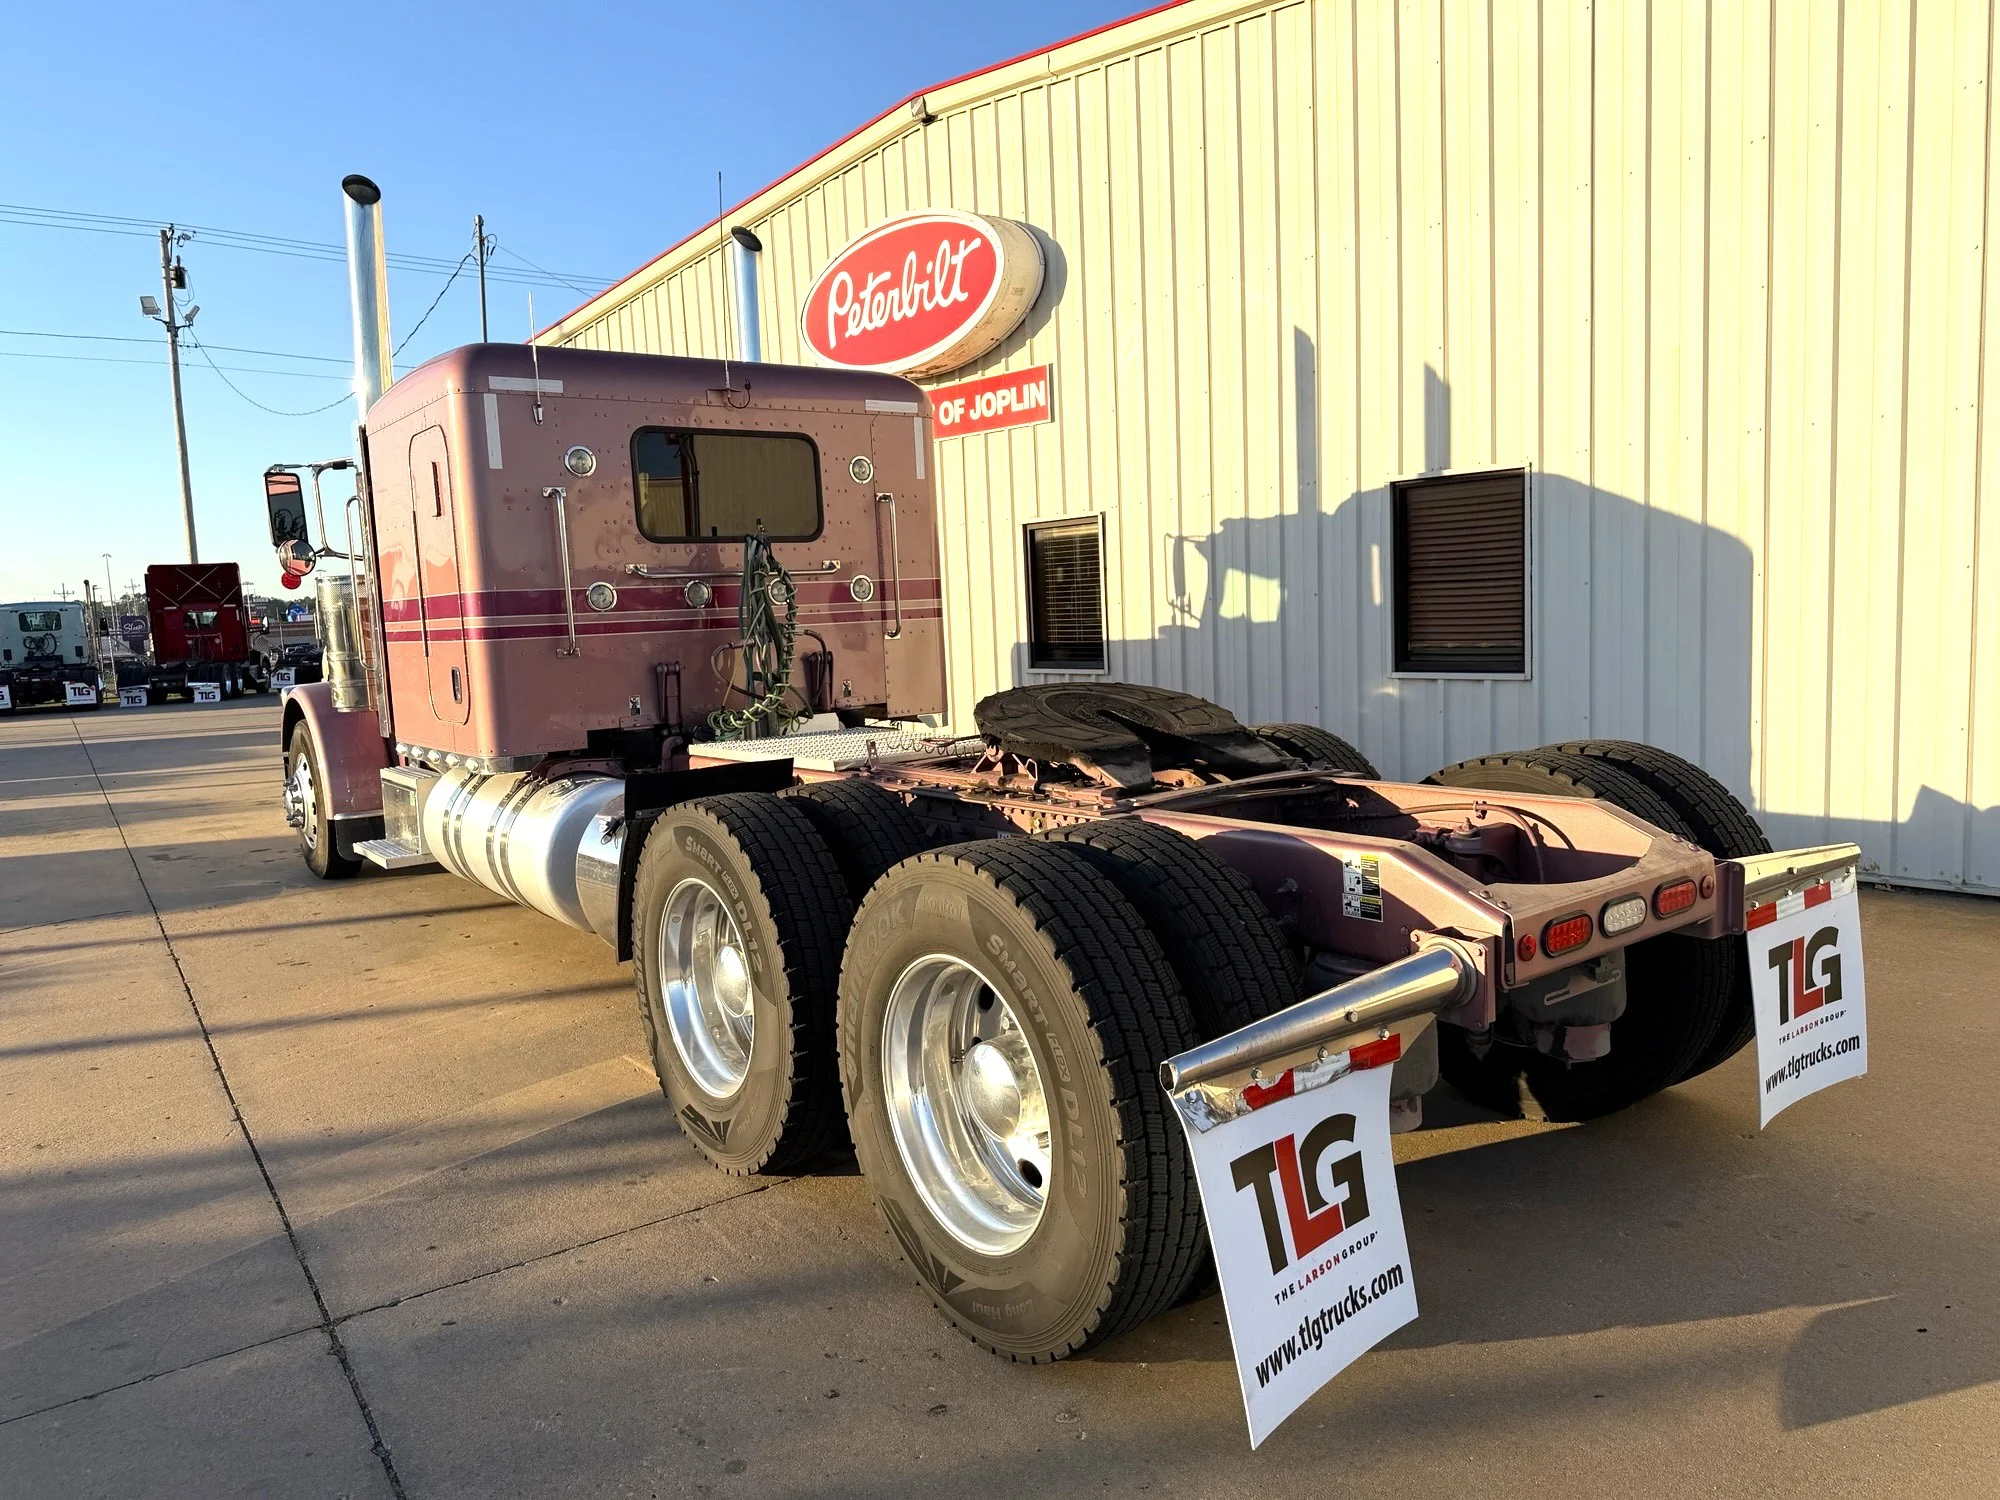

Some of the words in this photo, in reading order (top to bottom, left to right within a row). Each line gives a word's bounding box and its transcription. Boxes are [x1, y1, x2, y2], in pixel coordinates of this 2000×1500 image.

[827, 237, 982, 349] Peterbilt
[938, 398, 966, 426] OF
[969, 380, 1046, 421] JOPLIN
[70, 687, 91, 697] TLG
[124, 695, 142, 704] TLG
[198, 691, 216, 700] TLG
[735, 901, 763, 973] DL12
[1768, 926, 1843, 1026] TLG
[1765, 1034, 1861, 1095] www.tlgtrucks.com
[1779, 1033, 1790, 1045] THE
[1060, 1086, 1088, 1199] DL12
[1229, 1112, 1370, 1276] TLG
[1274, 1283, 1296, 1306] THE
[1297, 1253, 1341, 1291] LARSON
[972, 1301, 1001, 1320] Haul
[1005, 1299, 1037, 1316] Long
[1255, 1263, 1404, 1389] www.tlgtrucks.com
